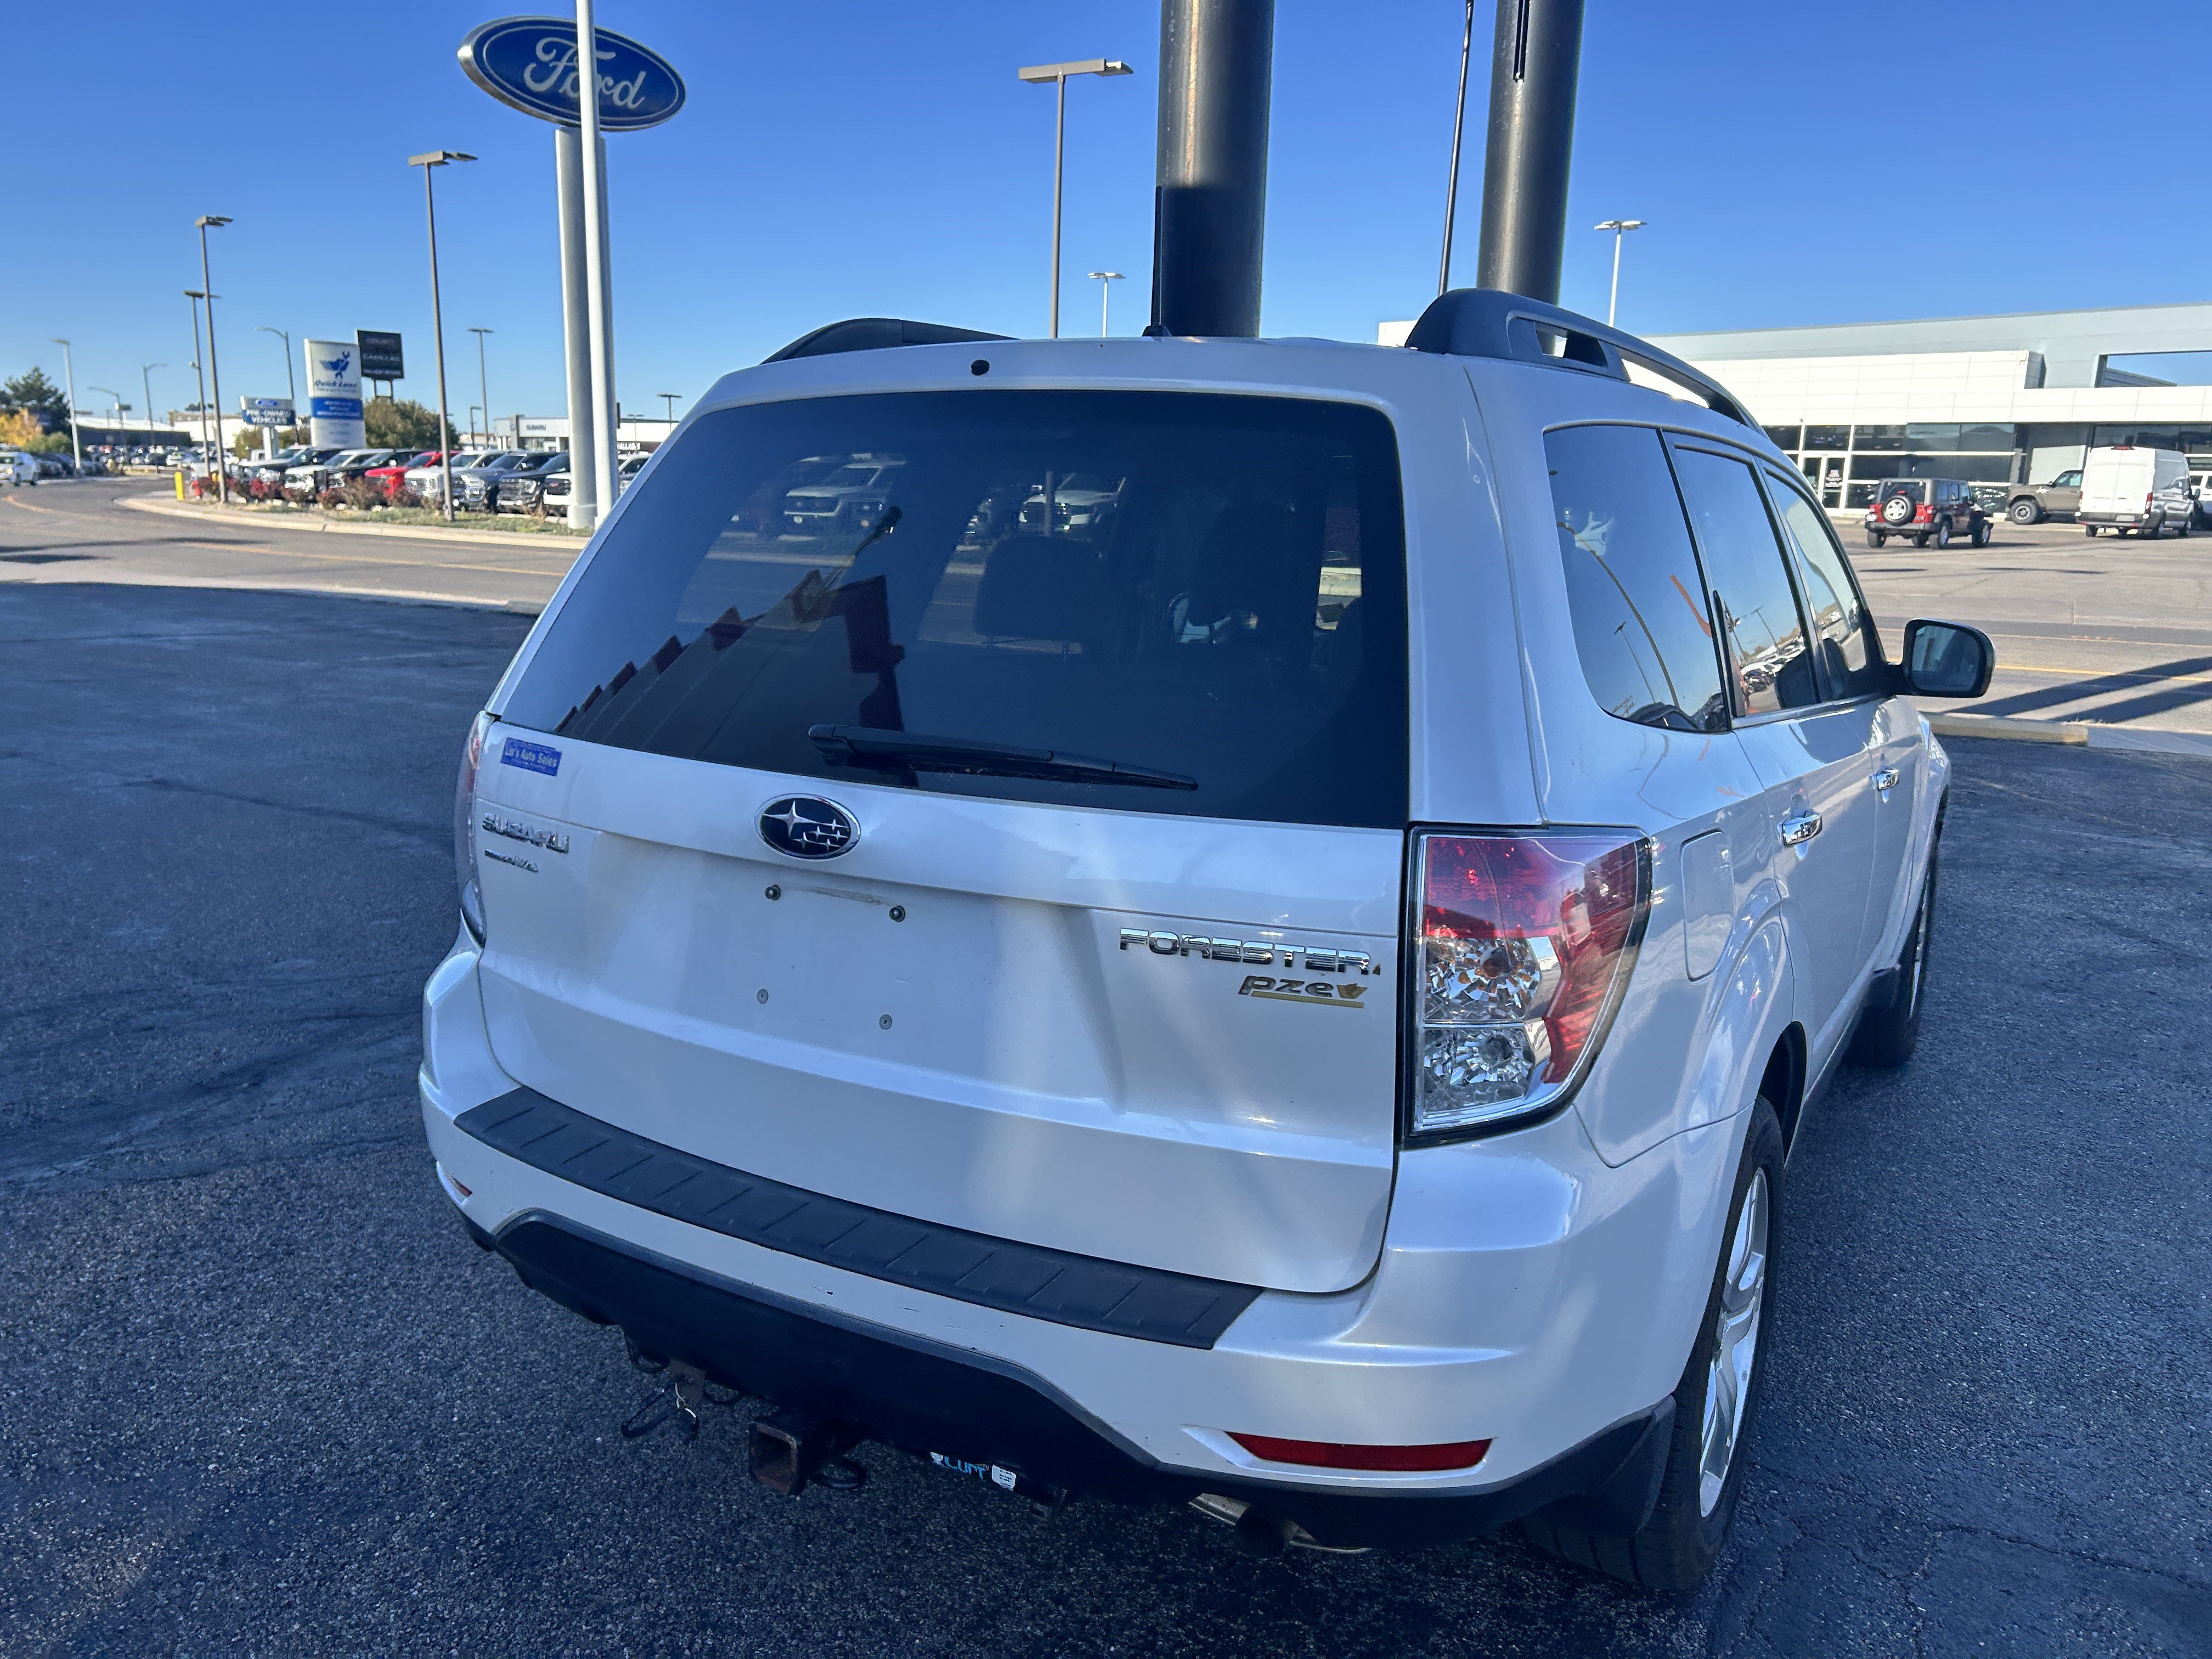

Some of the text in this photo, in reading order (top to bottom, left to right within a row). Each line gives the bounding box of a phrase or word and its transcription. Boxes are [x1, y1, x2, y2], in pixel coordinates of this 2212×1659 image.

[524, 37, 646, 109] Ford
[537, 752, 557, 768] Sales
[482, 812, 569, 854] SUBARU
[1120, 927, 1372, 975] FORESTER
